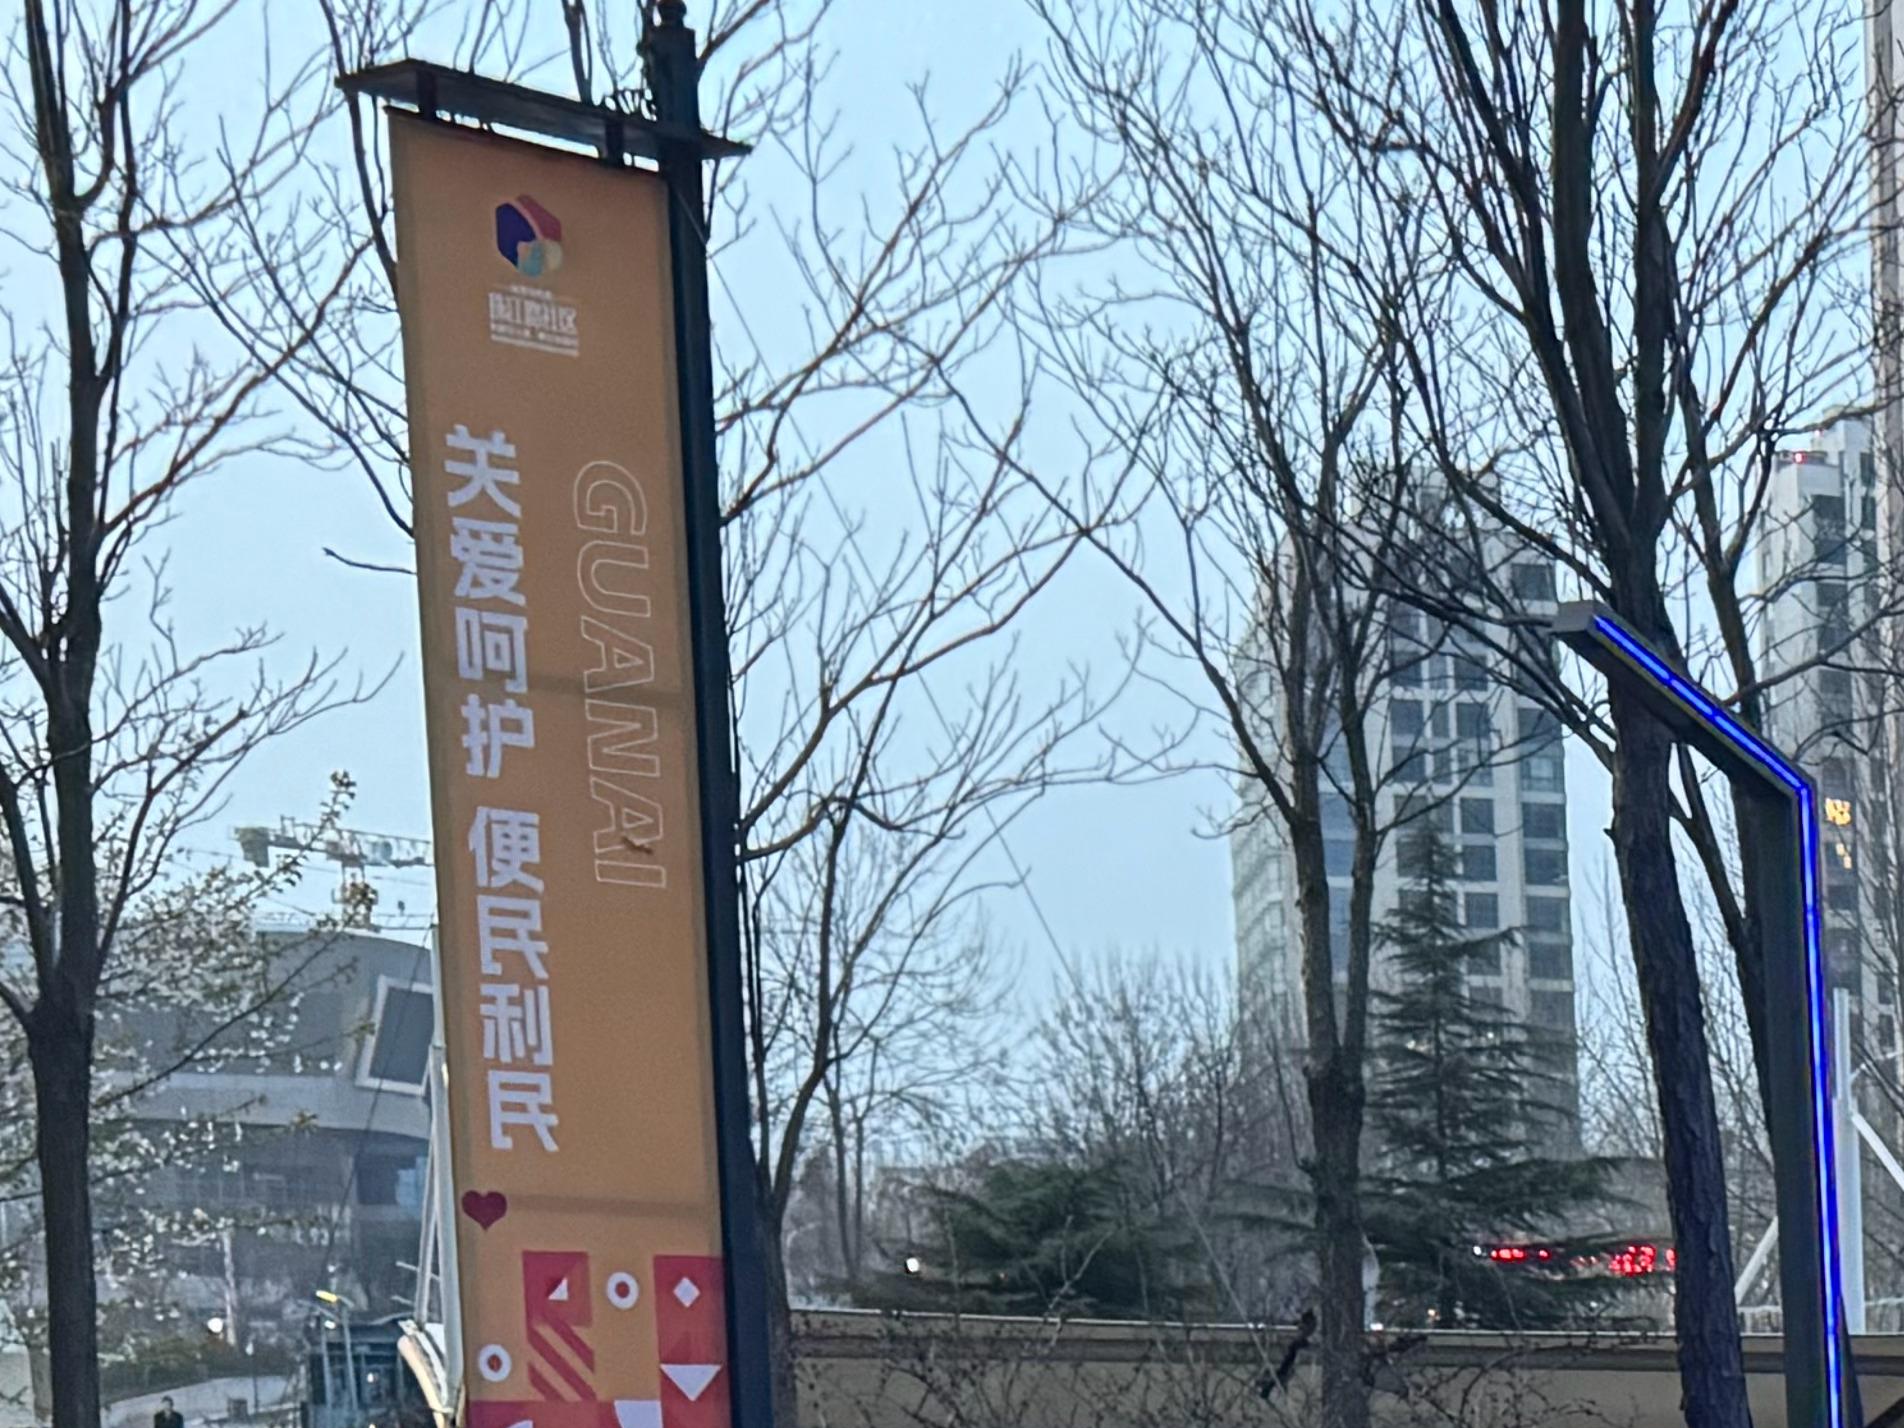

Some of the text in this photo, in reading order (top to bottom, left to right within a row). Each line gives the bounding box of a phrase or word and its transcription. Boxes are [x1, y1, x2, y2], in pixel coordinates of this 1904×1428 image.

[444, 423, 537, 780] 关爱呵护
[572, 460, 667, 889] GUANAI
[468, 805, 560, 1153] 便民利民
